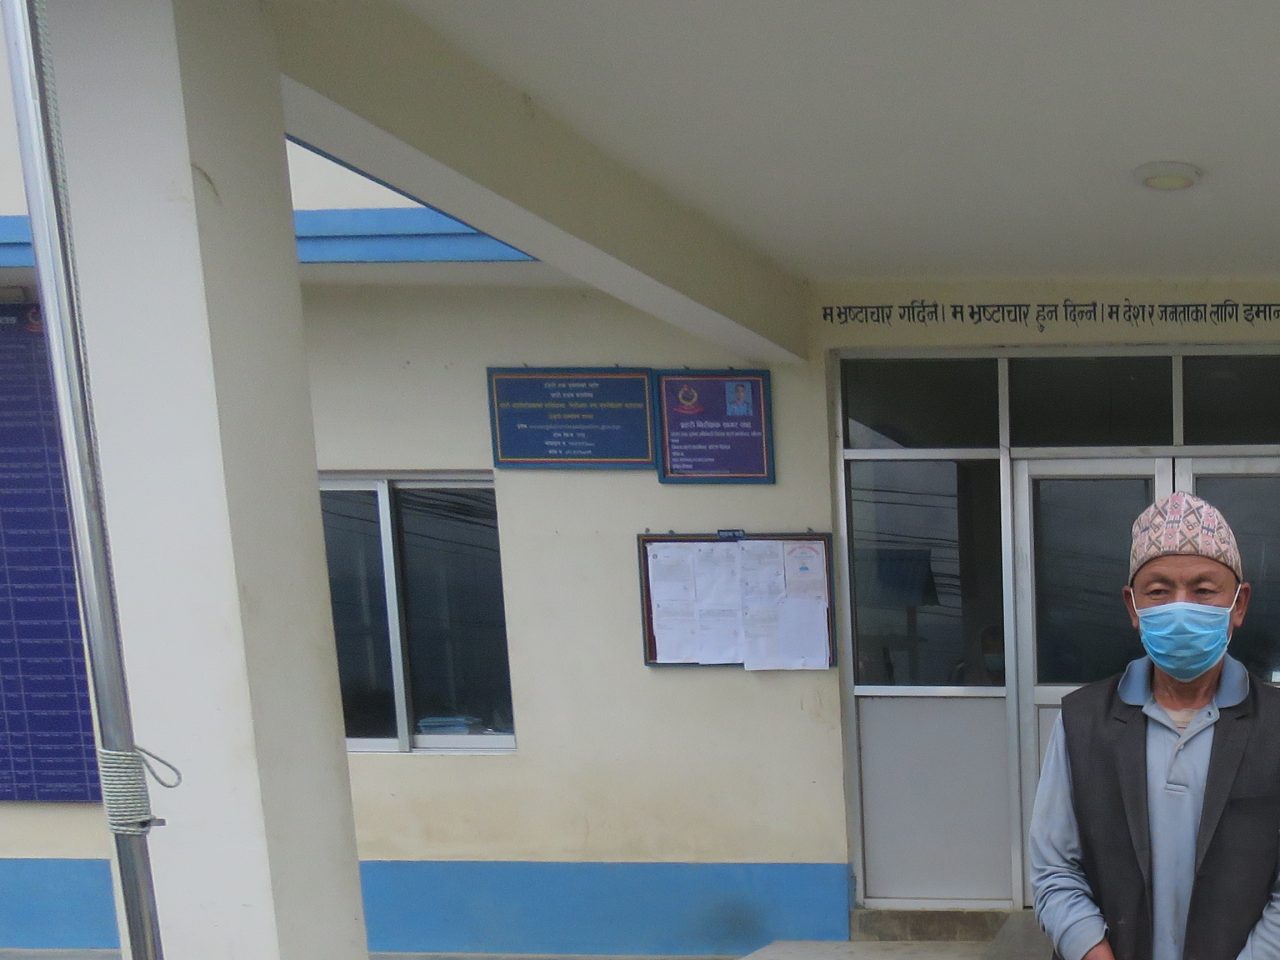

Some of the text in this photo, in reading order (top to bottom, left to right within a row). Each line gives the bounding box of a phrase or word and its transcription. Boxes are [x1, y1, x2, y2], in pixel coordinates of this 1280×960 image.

[822, 305, 834, 324] म
[836, 305, 893, 327] भ्रष्टाचार
[951, 304, 964, 323] म
[967, 304, 1031, 328] भ्रष्टाचार
[1035, 304, 1059, 333] हुन
[1107, 304, 1120, 323] म
[1123, 298, 1146, 328] देश
[1148, 304, 1156, 327] र
[1158, 303, 1208, 326] जनताका
[1210, 299, 1240, 326] लागि
